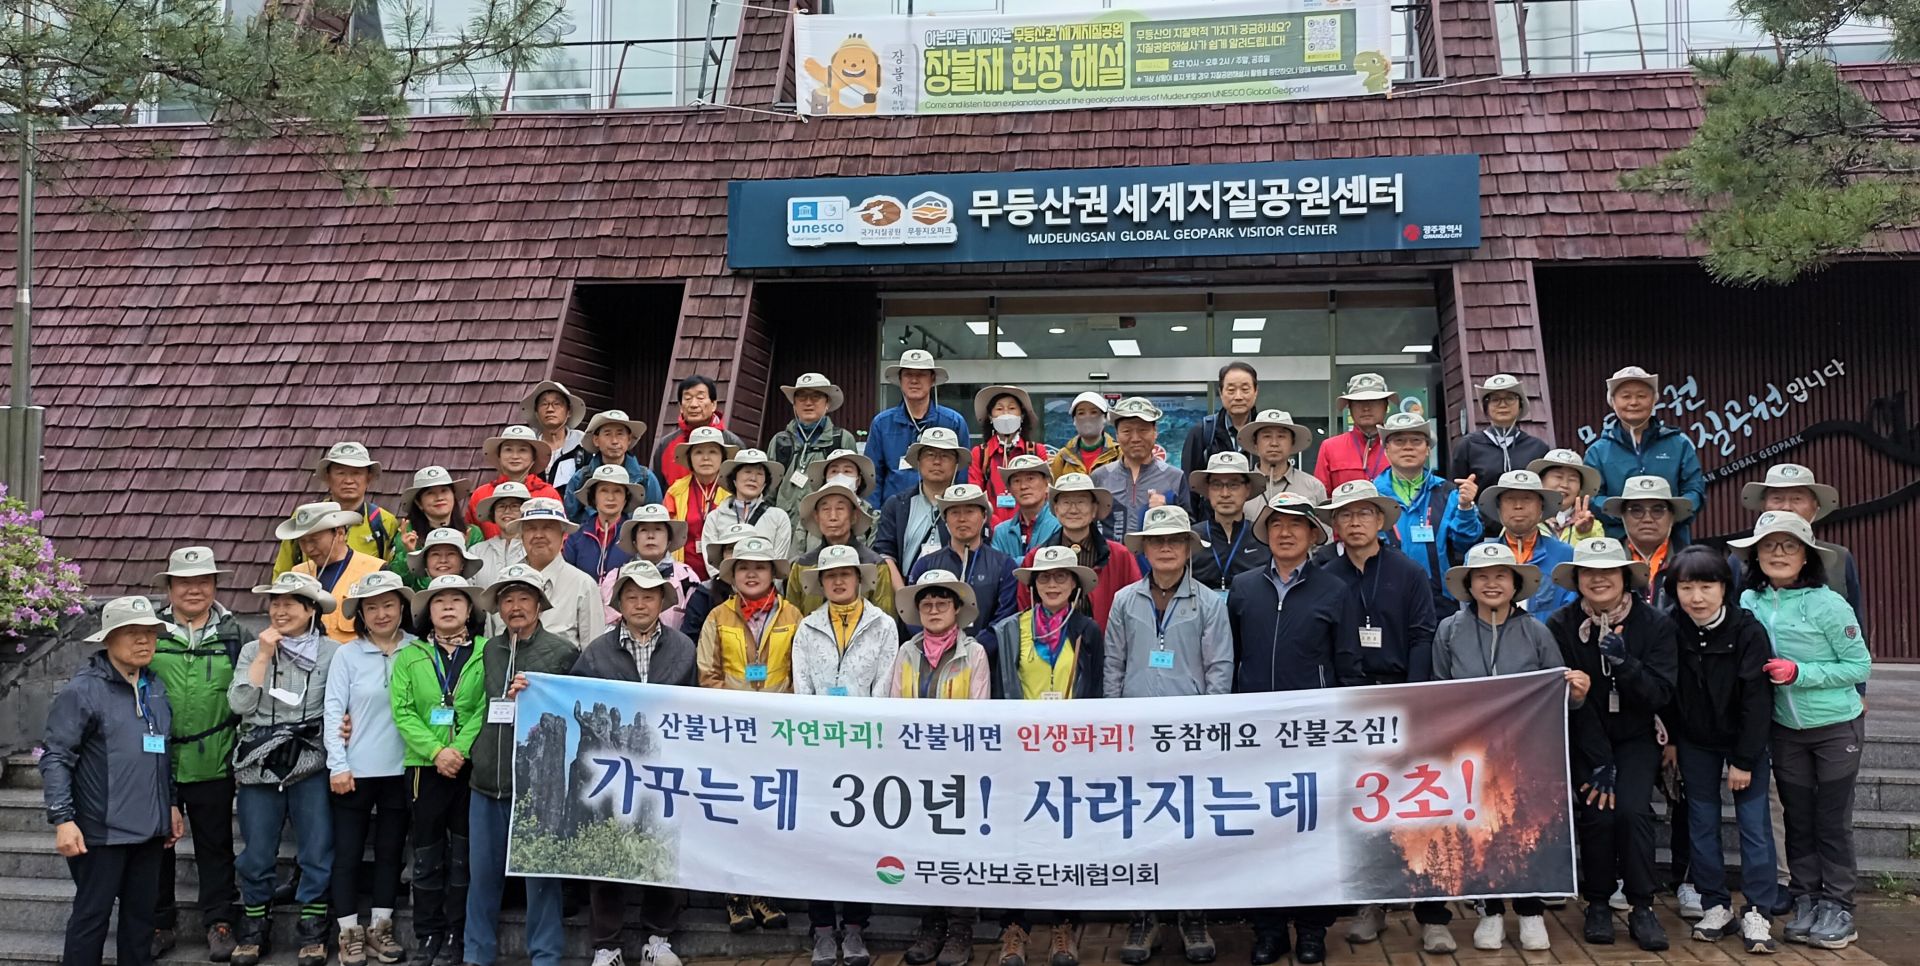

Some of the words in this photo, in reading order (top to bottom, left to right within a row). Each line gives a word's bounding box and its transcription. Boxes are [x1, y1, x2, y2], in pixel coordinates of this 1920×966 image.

[925, 29, 967, 47] 아는만큼
[969, 27, 1012, 45] 재미있는
[1014, 25, 1057, 43] 무등산권
[1059, 22, 1123, 41] 세계지질공원
[1136, 28, 1171, 40] 무등산의
[1173, 26, 1208, 38] 지질학적
[1211, 24, 1237, 36] 가치가
[1240, 21, 1291, 35] 궁금하세요?
[1136, 40, 1206, 54] 지질공원해설사가
[1208, 38, 1228, 50] 쉽게
[1229, 35, 1286, 49] 알려드립니다!
[891, 48, 905, 97] 장불재
[925, 47, 1004, 93] 장불재
[1012, 45, 1063, 91] 현장
[1070, 42, 1124, 88] 해설
[925, 101, 946, 109] Come
[964, 100, 982, 108] listen
[983, 100, 991, 108] to
[1003, 98, 1047, 108] explanation
[1048, 98, 1070, 106] about
[1086, 95, 1124, 105] geological
[1160, 91, 1211, 102] Mudeungsan
[1212, 89, 1245, 98] UNESCO
[1246, 87, 1271, 96] Global
[967, 184, 1109, 228] 무등산권
[1113, 173, 1404, 223] 세계지질공원센터
[792, 223, 844, 234] unesco
[861, 228, 901, 237] 국가지질공원
[907, 226, 952, 236] 무등지오파크
[1028, 231, 1116, 245] MUDEUNGSAN
[1120, 229, 1170, 242] GLOBAL
[1173, 227, 1234, 240] GEOPARK
[1238, 225, 1284, 238] VISITOR
[1288, 223, 1337, 236] CENTER
[1422, 224, 1463, 234] 광주광역시
[1786, 358, 1846, 403] 입니다
[1720, 455, 1758, 477] GLOBAL
[1759, 434, 1804, 460] GEOPARK
[657, 712, 757, 744] 산불나면
[771, 718, 883, 749] 자연파괴!
[898, 722, 1002, 752] 산불내면
[1017, 724, 1135, 753] 인생파괴!
[1150, 721, 1261, 752] 동참해요
[1274, 716, 1398, 748] 산불조심!
[588, 755, 799, 831] 가꾸는데
[830, 774, 992, 836] 30년!
[1023, 771, 1318, 839] 사라지는데
[1351, 759, 1477, 823] 3초!
[914, 860, 1159, 887] 무등산보호단체협의회
